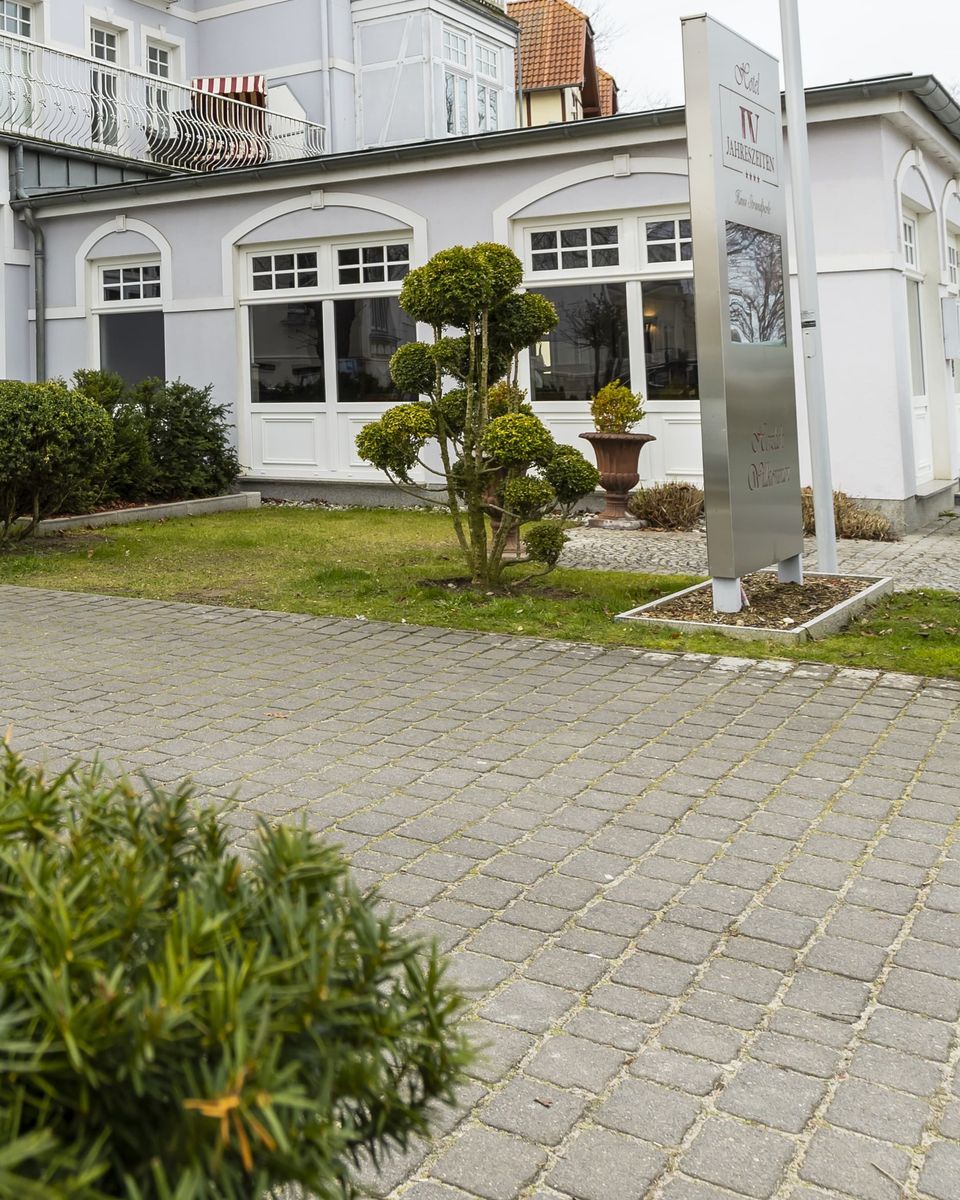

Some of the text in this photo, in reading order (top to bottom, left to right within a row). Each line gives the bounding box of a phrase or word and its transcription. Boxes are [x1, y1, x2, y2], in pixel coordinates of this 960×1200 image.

[735, 62, 760, 96] Hotel
[739, 105, 760, 145] IV
[726, 136, 775, 172] JAHRESZEITEN
